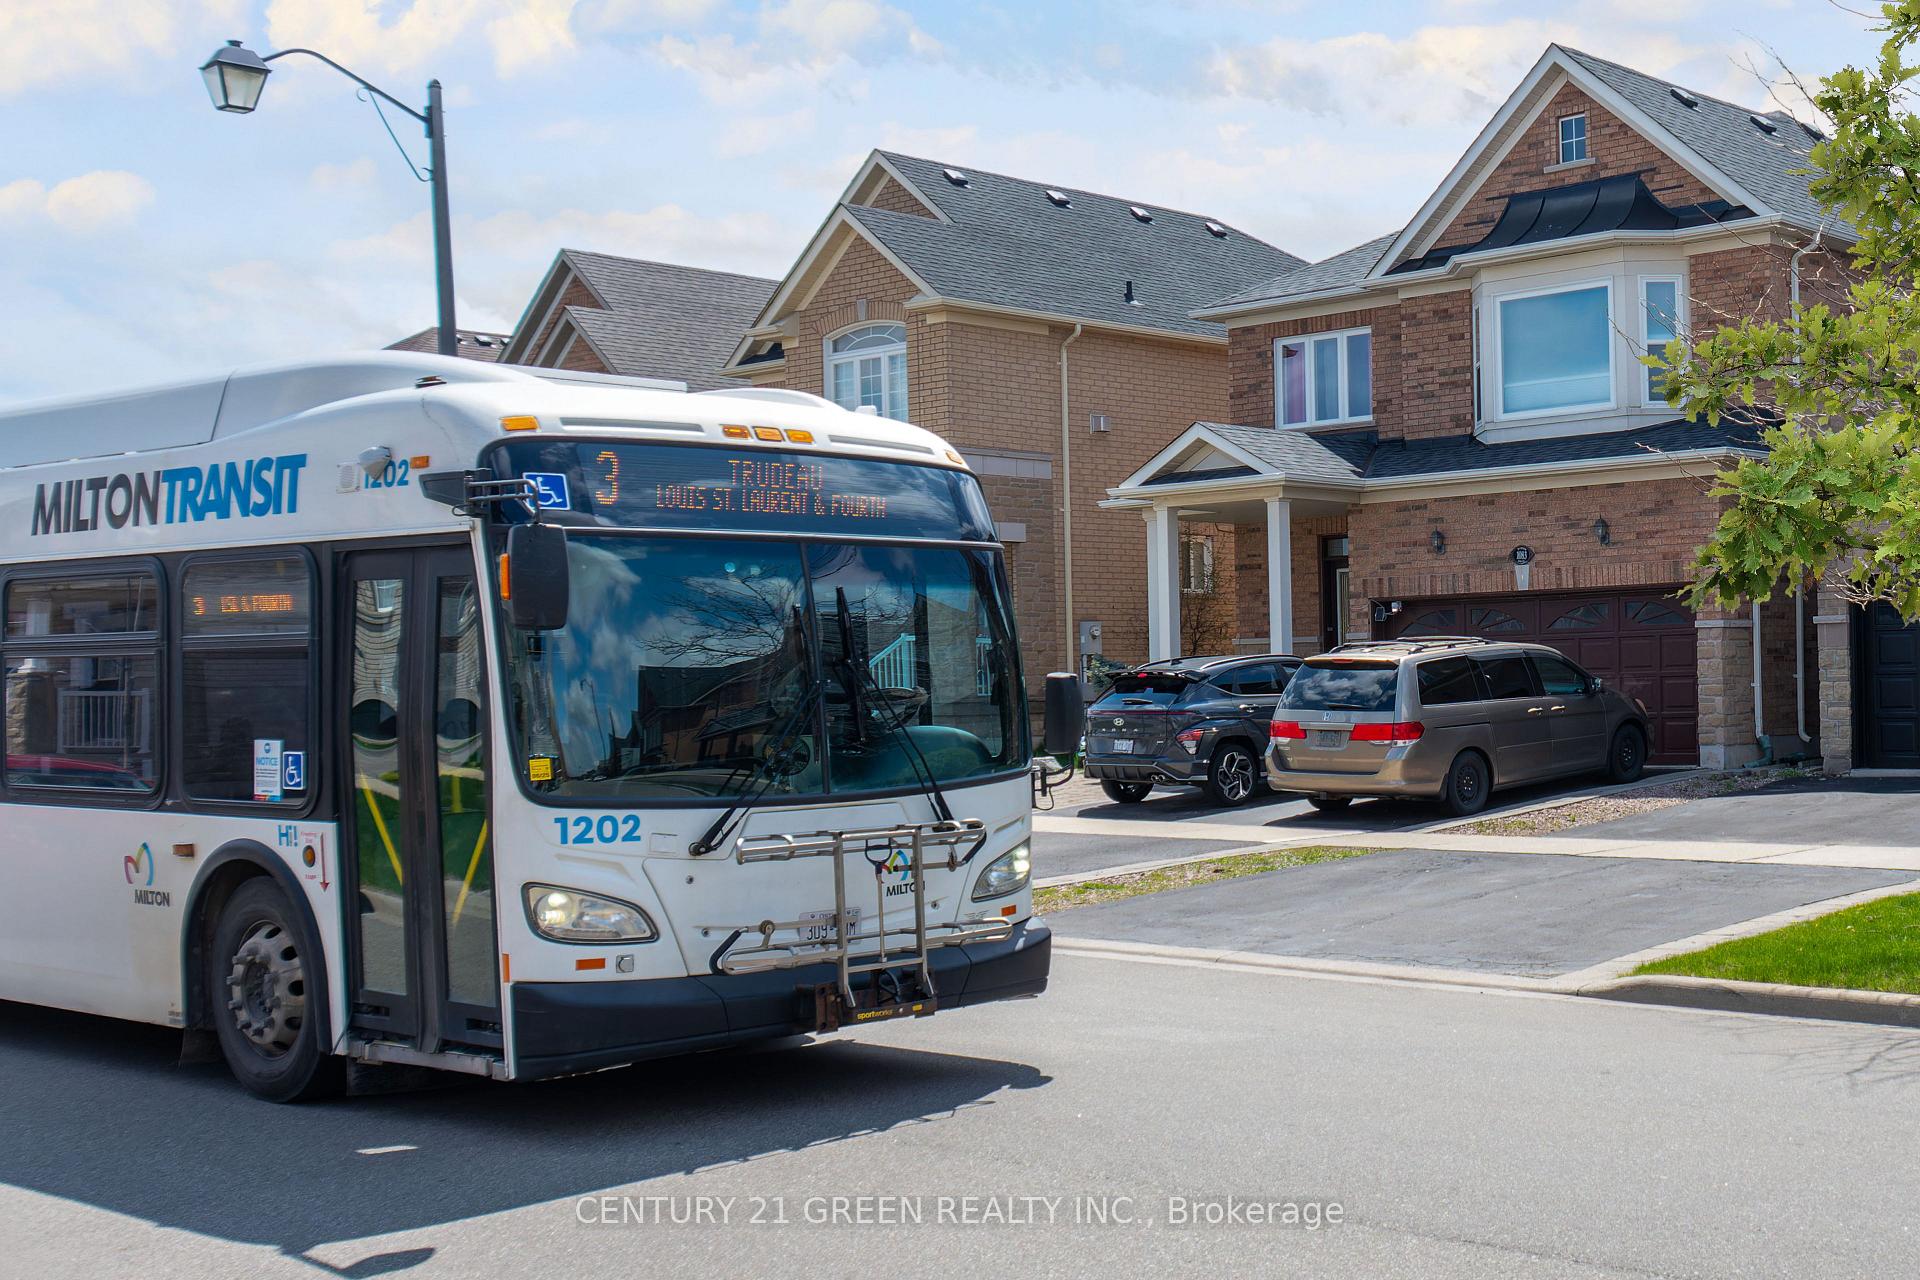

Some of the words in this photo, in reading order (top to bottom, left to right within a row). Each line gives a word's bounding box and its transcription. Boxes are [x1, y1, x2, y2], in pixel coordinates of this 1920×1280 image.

[596, 451, 619, 505] 3
[728, 460, 823, 490] TRUDEAU
[656, 484, 705, 509] LOUIS
[713, 487, 735, 511] ST.
[742, 489, 808, 514] LAURENT
[815, 493, 825, 515] &
[831, 494, 887, 518] FOURTH
[192, 597, 205, 615] 3
[554, 814, 641, 844] 1202
[135, 889, 170, 907] MILTON
[857, 1009, 893, 1020] sportworks
